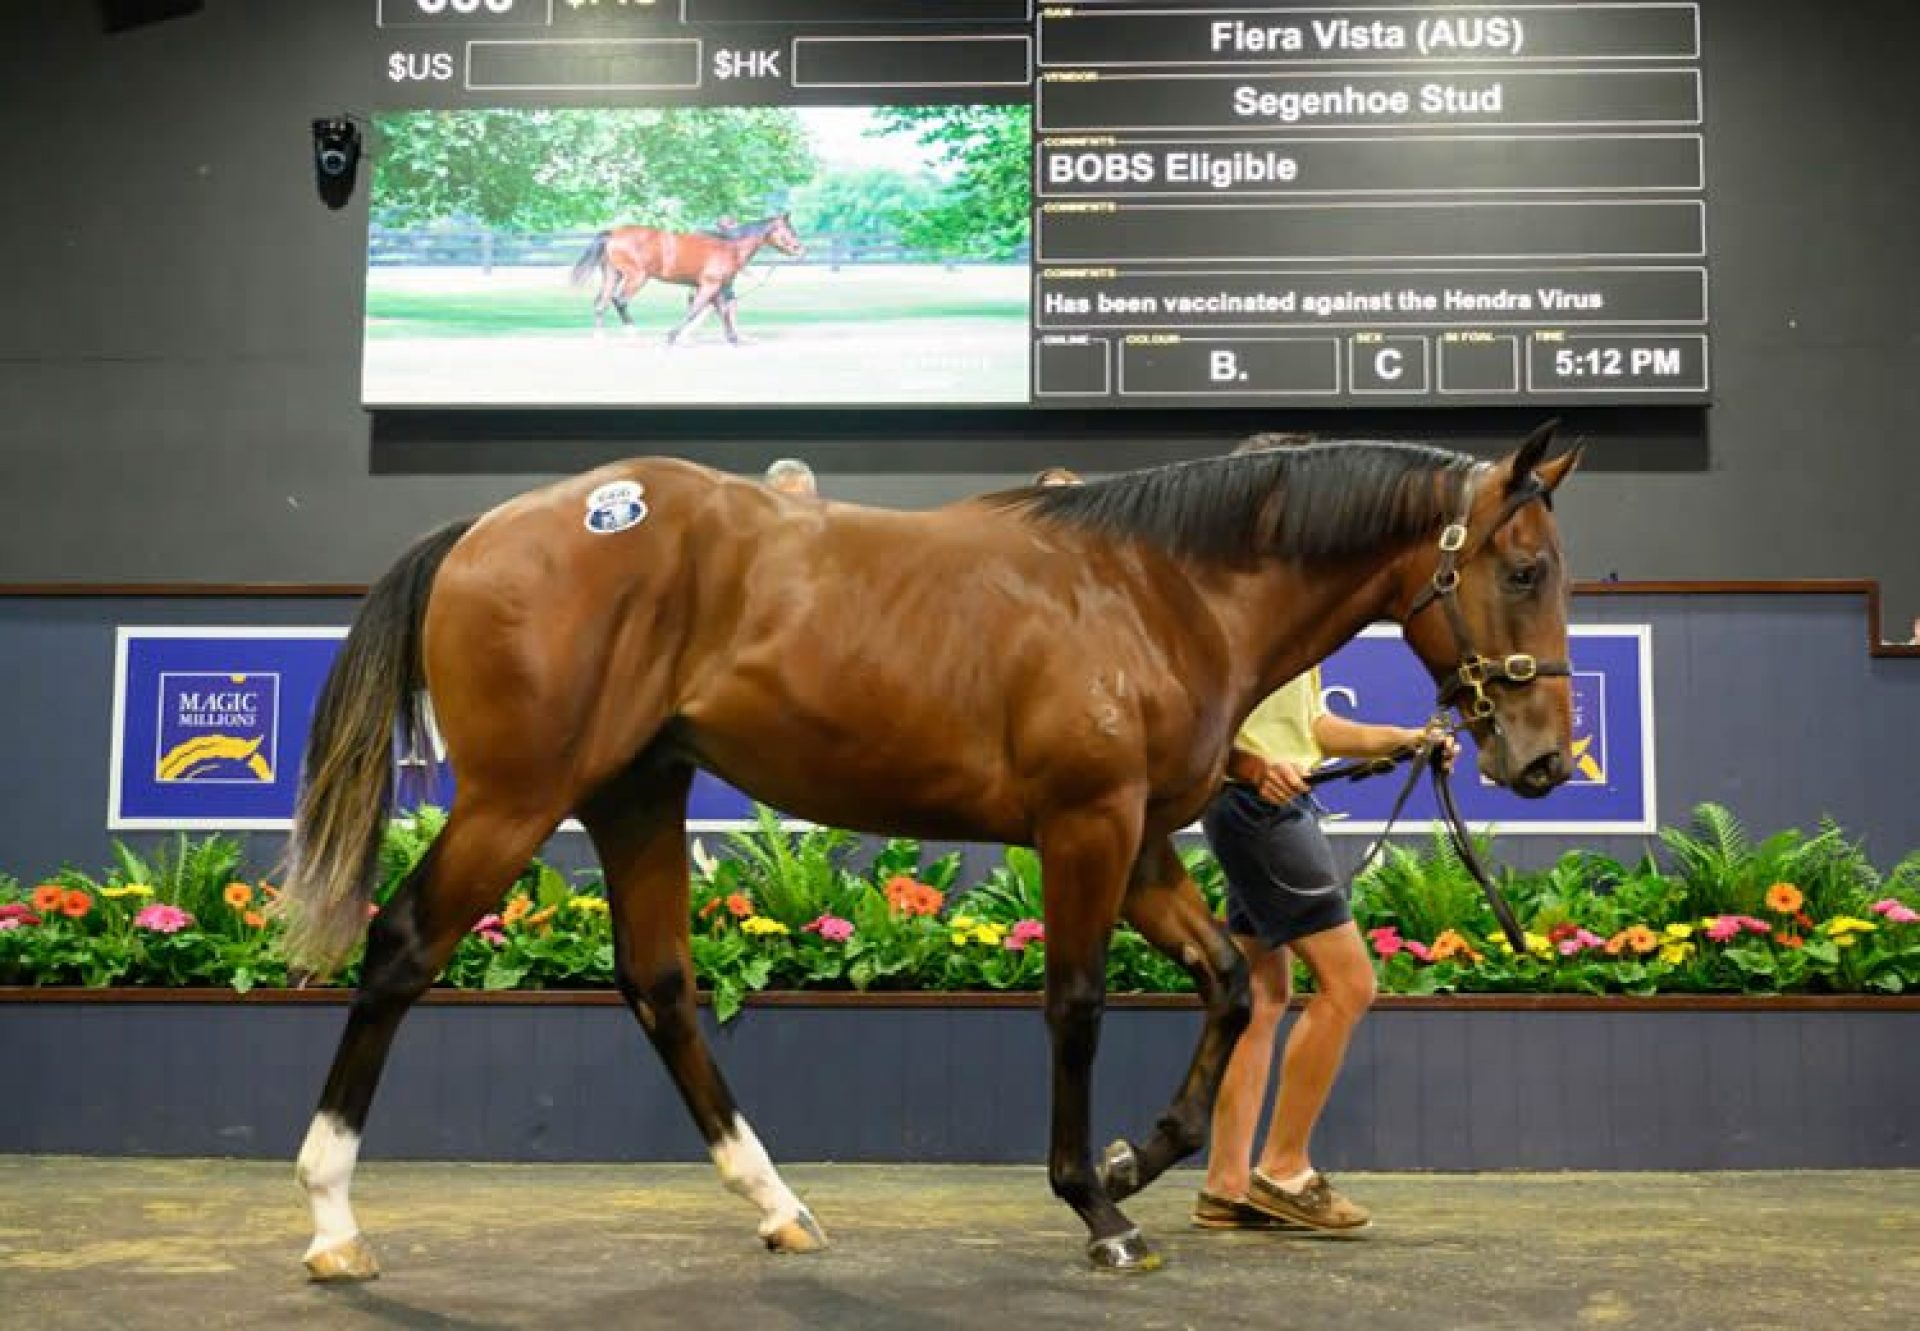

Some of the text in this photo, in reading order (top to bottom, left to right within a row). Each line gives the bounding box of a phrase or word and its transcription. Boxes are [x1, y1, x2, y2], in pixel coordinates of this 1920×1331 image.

[1211, 17, 1524, 55] Fiera Vista (AUS)
[388, 51, 453, 82] $US
[713, 48, 781, 79] $HK
[1233, 83, 1503, 121] Segenhoe Stud
[1049, 151, 1297, 188] BOBS Eligible
[1045, 289, 1604, 316] Has been vaccinated against the Hendra Virus
[1210, 350, 1249, 381] B.
[1374, 347, 1403, 380] C
[1555, 347, 1681, 376] 5:12 PM
[178, 692, 258, 712] MAGIC
[178, 713, 257, 728] MILLIONS
